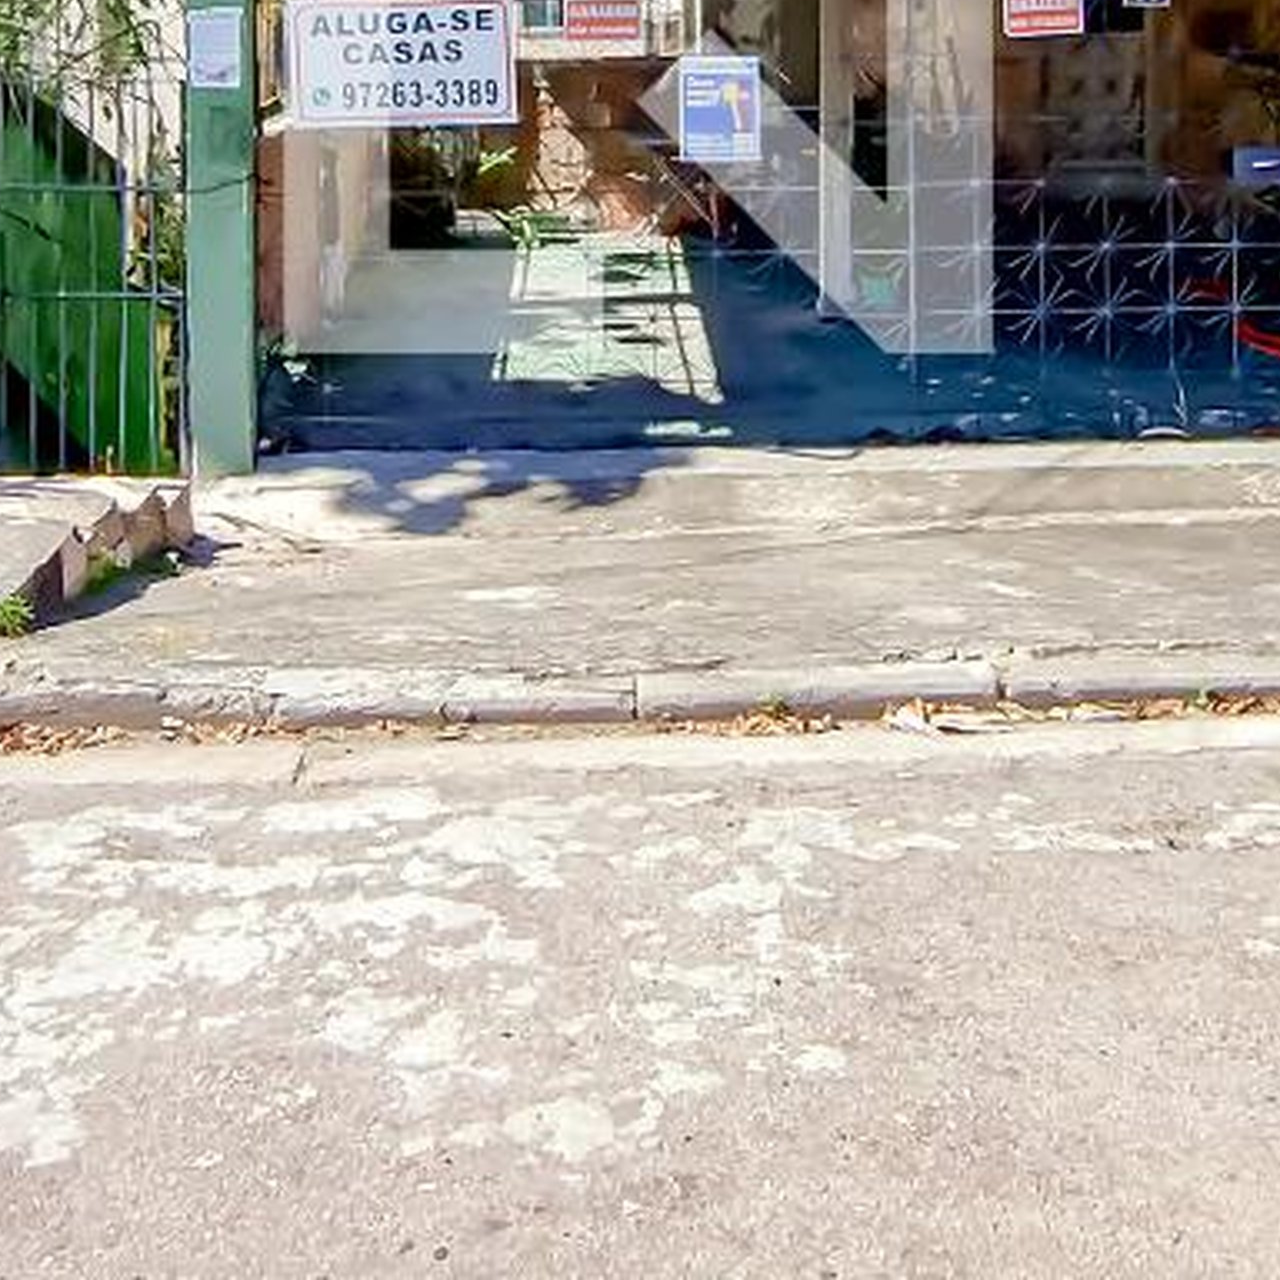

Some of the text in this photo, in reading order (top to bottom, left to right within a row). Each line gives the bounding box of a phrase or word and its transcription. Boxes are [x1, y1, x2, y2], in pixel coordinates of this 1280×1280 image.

[310, 8, 495, 37] ALUGA-SE
[343, 39, 463, 65] CASAS
[342, 79, 499, 109] 97263-3389
